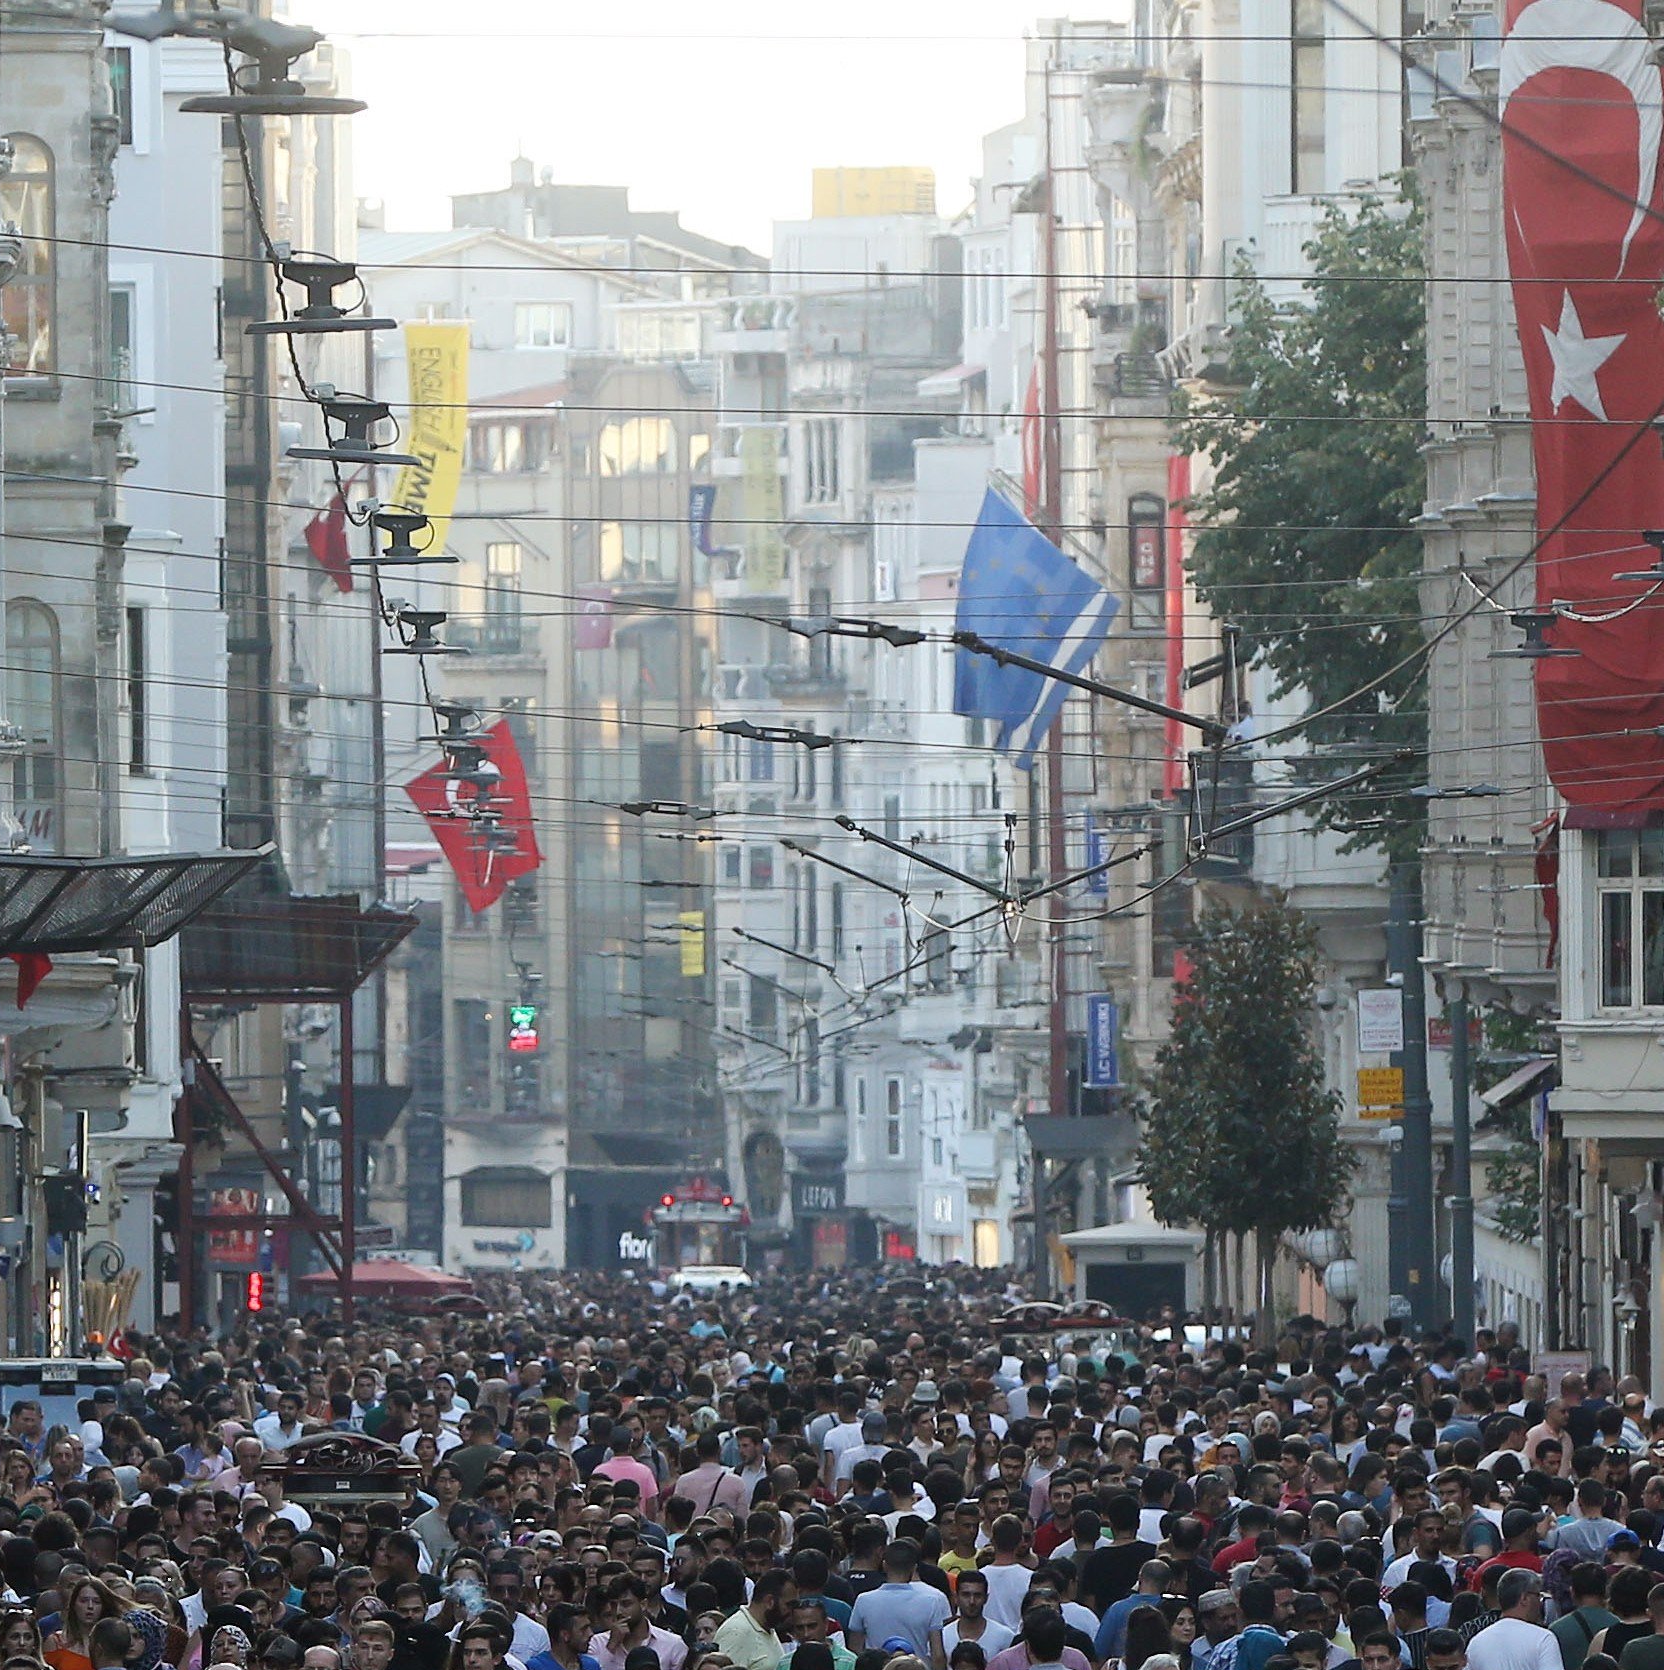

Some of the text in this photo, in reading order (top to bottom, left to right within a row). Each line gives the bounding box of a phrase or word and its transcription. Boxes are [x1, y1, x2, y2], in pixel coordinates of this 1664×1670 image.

[403, 346, 443, 516] ENGLISH TIME
[619, 1230, 651, 1259] flor
